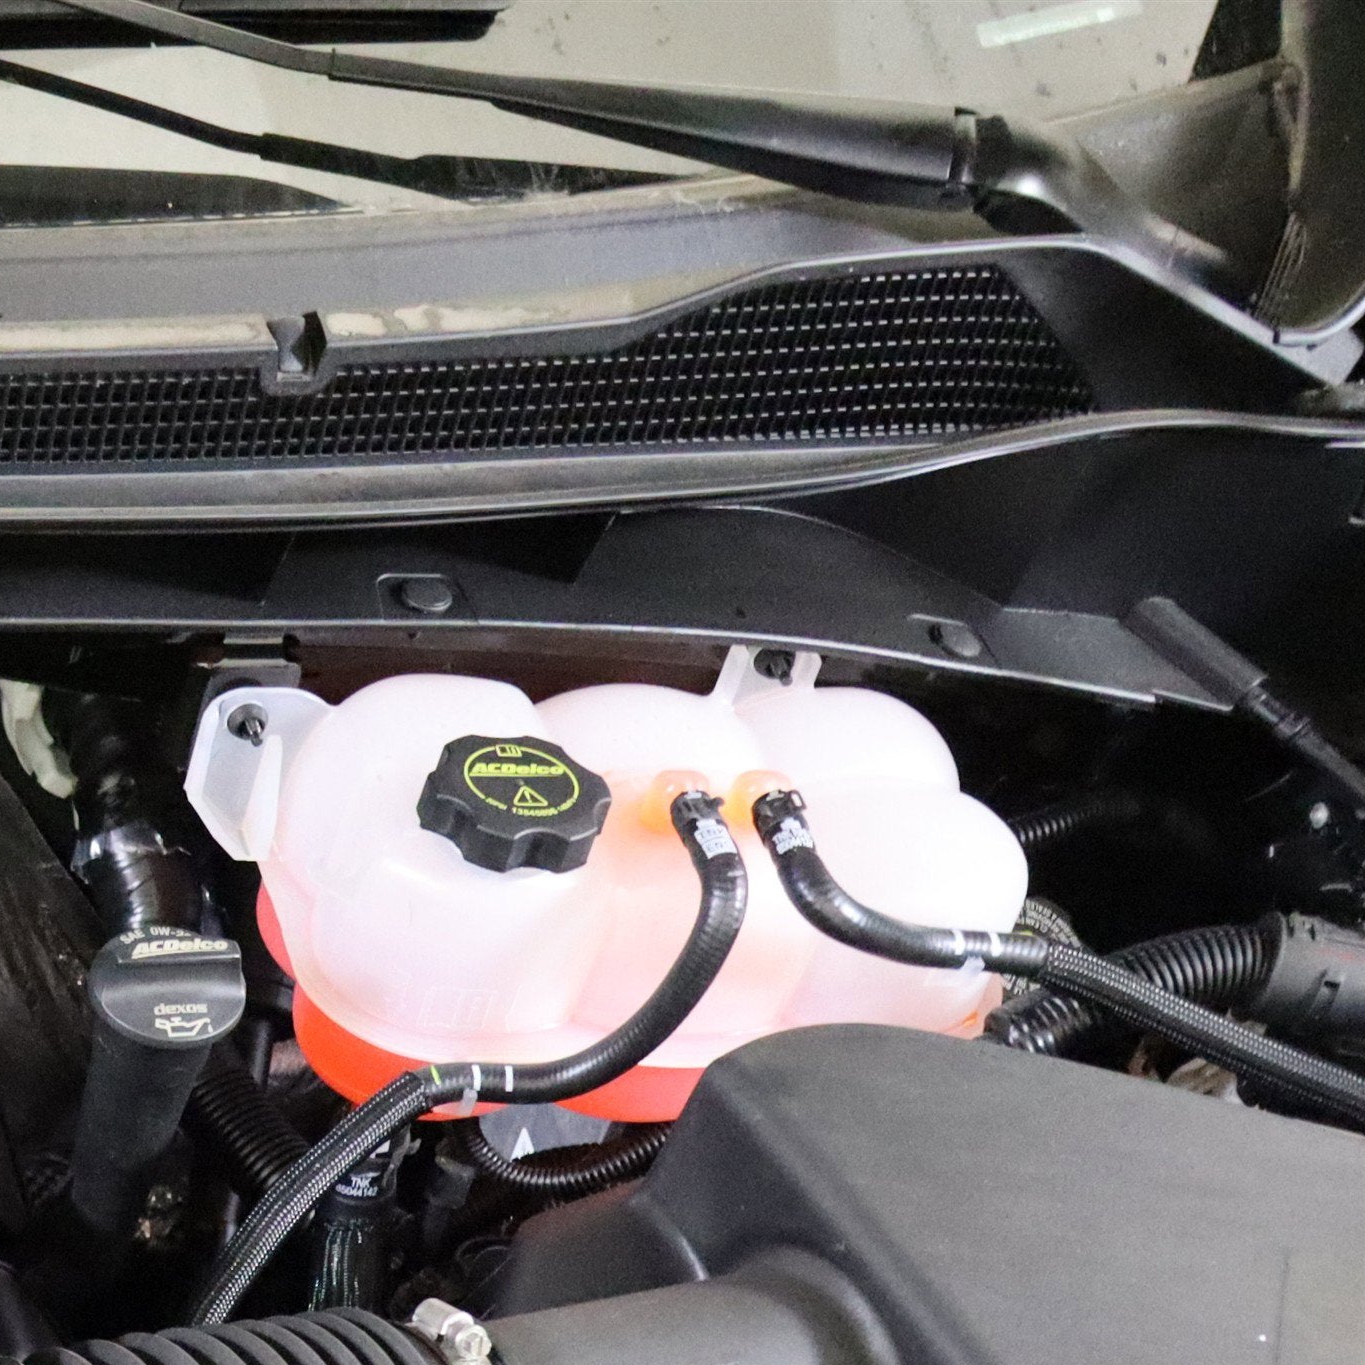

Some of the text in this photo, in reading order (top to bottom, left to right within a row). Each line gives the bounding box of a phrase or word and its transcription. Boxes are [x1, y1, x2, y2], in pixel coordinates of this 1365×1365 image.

[470, 762, 565, 776] ACDelco
[119, 928, 146, 945] SAE
[131, 938, 229, 958] ACDelco
[153, 1002, 209, 1016] dexos
[350, 1177, 372, 1188] TNK
